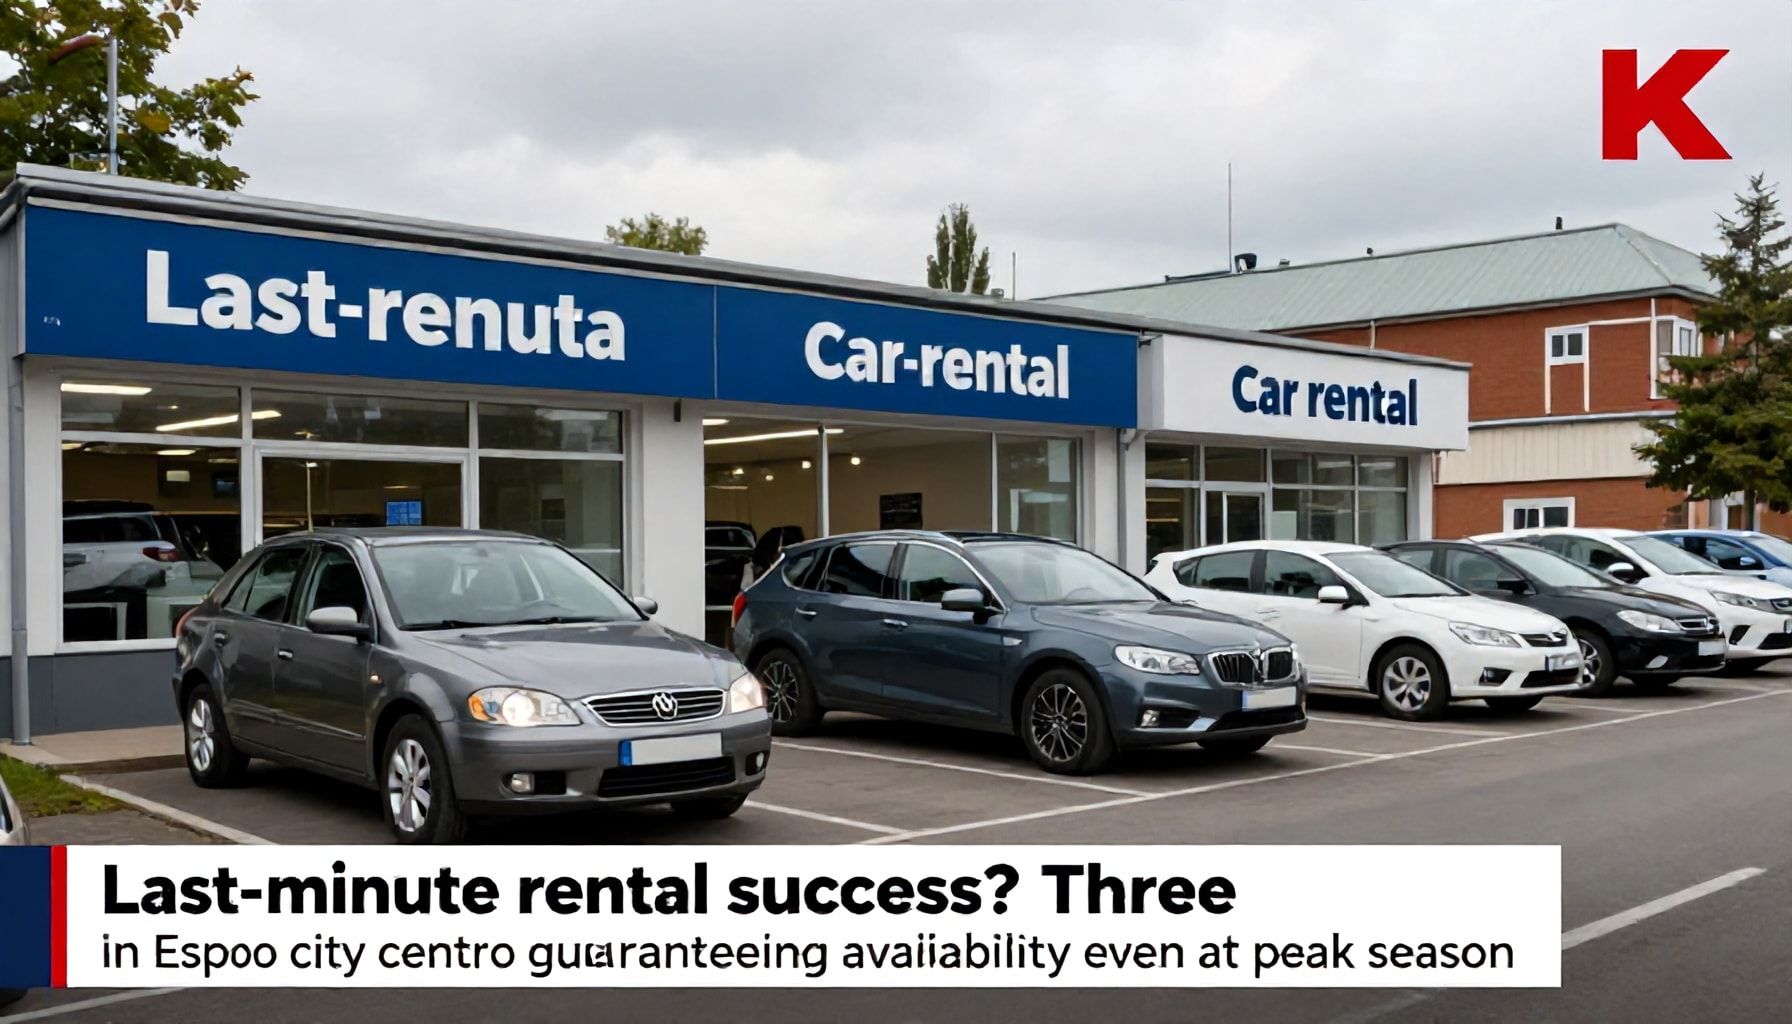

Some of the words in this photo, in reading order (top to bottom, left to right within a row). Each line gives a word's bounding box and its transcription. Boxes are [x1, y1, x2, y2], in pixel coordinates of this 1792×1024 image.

[146, 249, 627, 361] Last-renuta
[804, 320, 1070, 399] Car-rental
[1232, 365, 1299, 416] Car
[1308, 378, 1418, 426] rental
